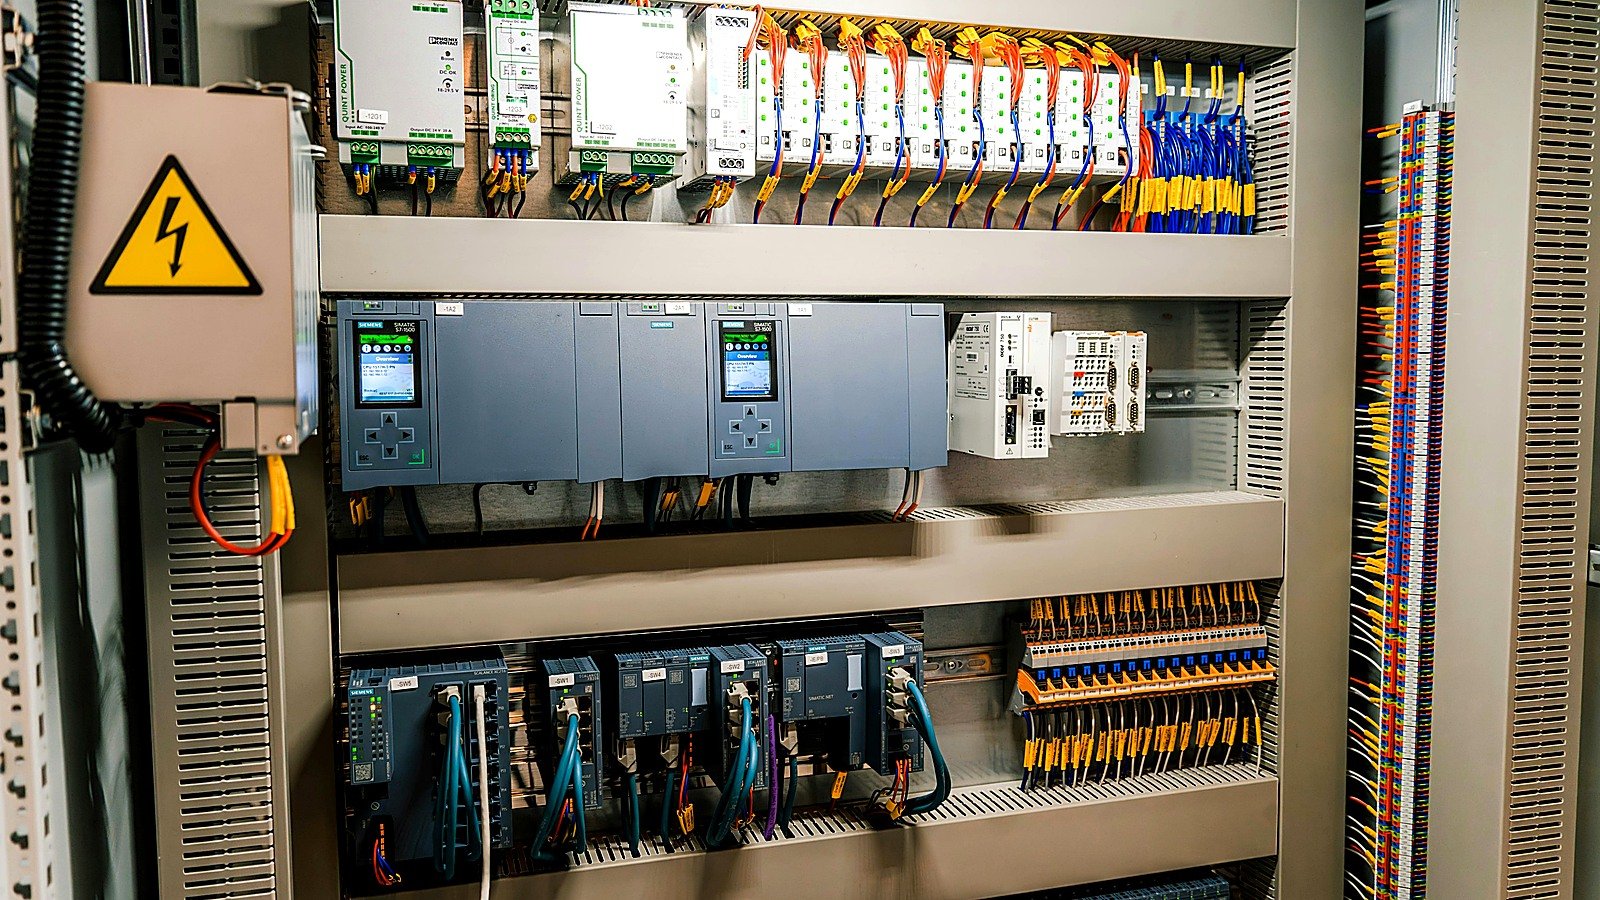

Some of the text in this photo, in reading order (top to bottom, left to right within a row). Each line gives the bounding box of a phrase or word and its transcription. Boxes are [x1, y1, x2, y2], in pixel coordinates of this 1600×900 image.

[726, 663, 741, 671] -SW2
[648, 671, 662, 679] -SW4
[554, 677, 569, 685] -SW1
[350, 688, 374, 696] SIEMENS
